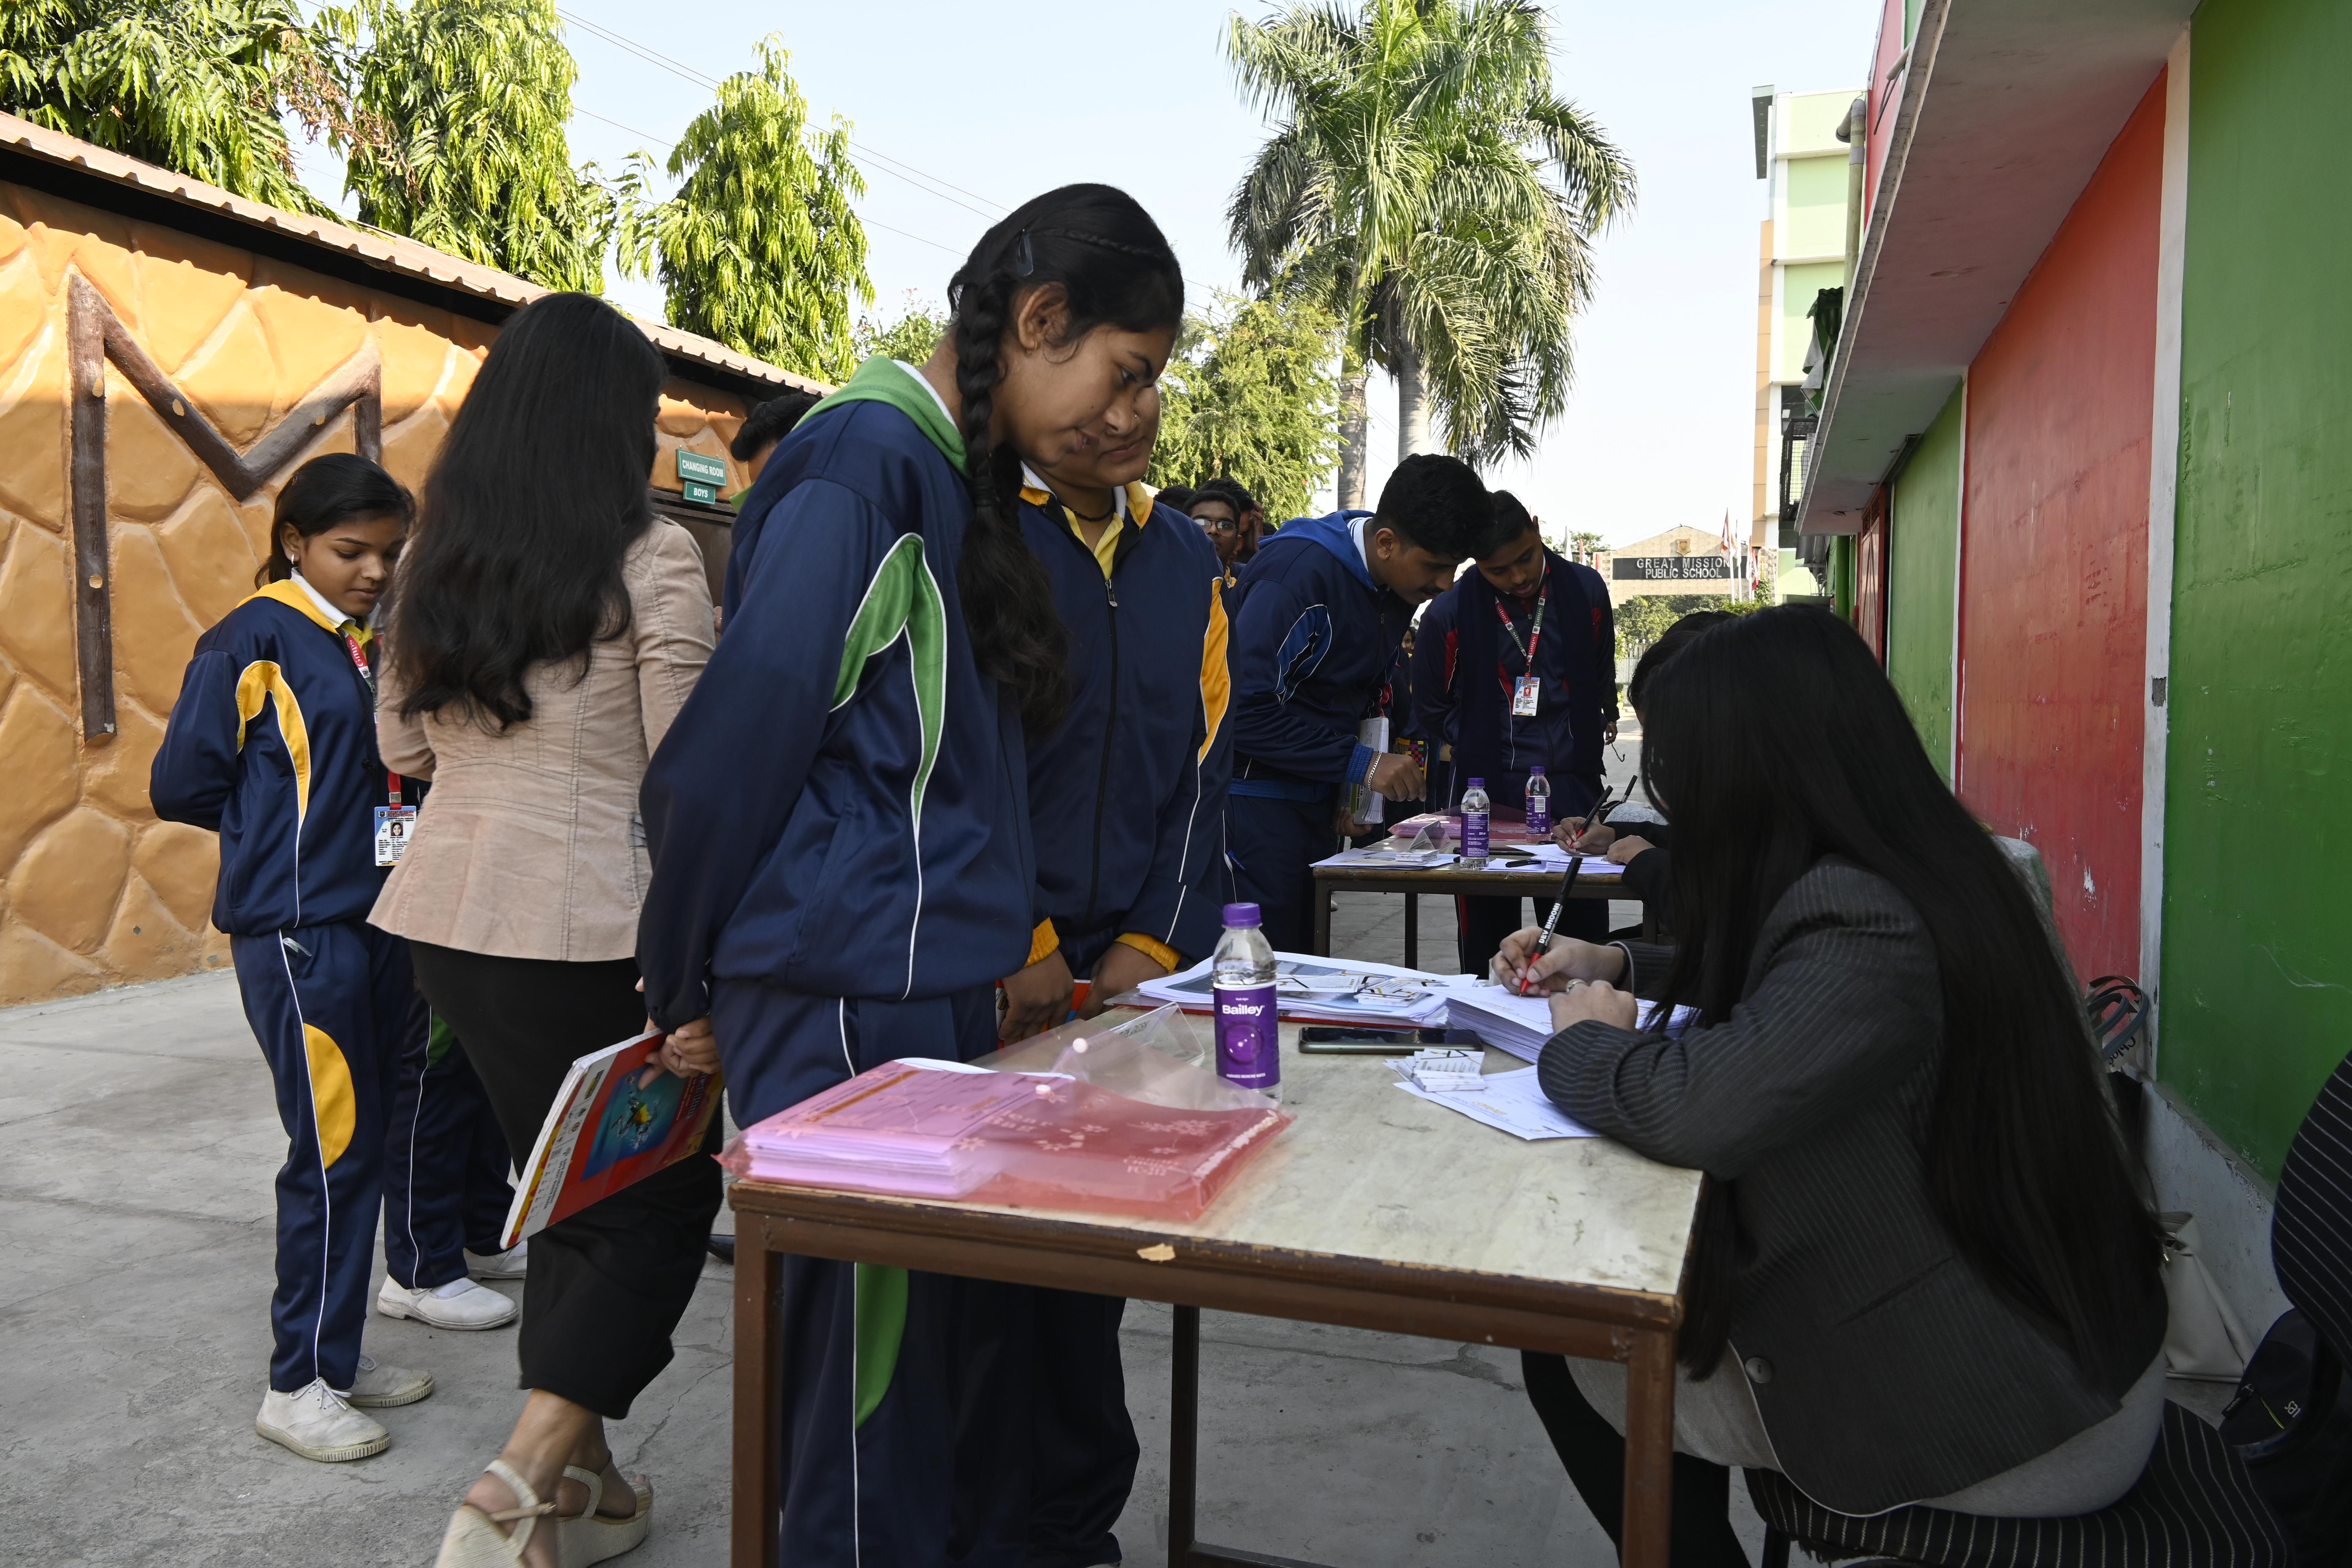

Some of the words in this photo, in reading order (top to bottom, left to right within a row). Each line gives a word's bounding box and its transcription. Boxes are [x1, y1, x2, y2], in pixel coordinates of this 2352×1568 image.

[682, 459, 708, 474] CHANGING
[709, 466, 724, 477] ROOM
[694, 487, 708, 498] BOYS
[1636, 558, 1675, 569] GREAT
[1682, 558, 1730, 569] MISSION
[1645, 568, 1678, 579] PUBLIC
[1682, 568, 1722, 578] SCHOOL
[1538, 930, 1549, 944] DEV
[1544, 903, 1561, 930] BHOOMI
[1222, 1004, 1263, 1016] Bailley
